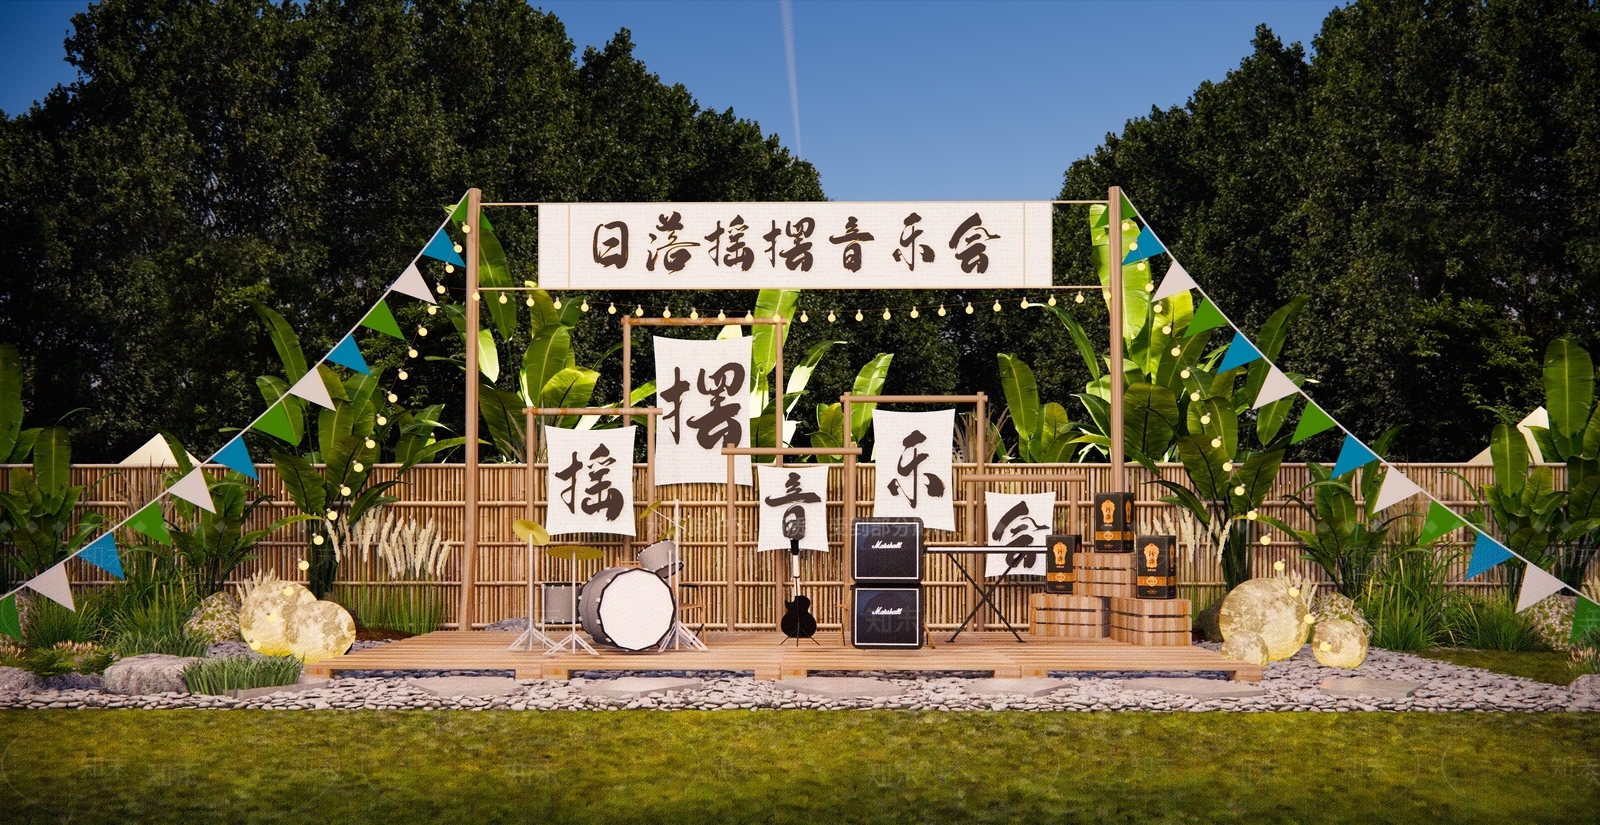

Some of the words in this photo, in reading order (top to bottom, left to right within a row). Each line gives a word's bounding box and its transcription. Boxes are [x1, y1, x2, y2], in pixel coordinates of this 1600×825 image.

[592, 212, 1001, 274] 日落摇摆音乐会
[660, 362, 745, 451] 摆
[555, 443, 624, 522] 摇
[888, 430, 946, 507] 乐
[765, 472, 822, 541] 音
[872, 541, 902, 549] Marshall
[872, 607, 902, 615] Marshall
